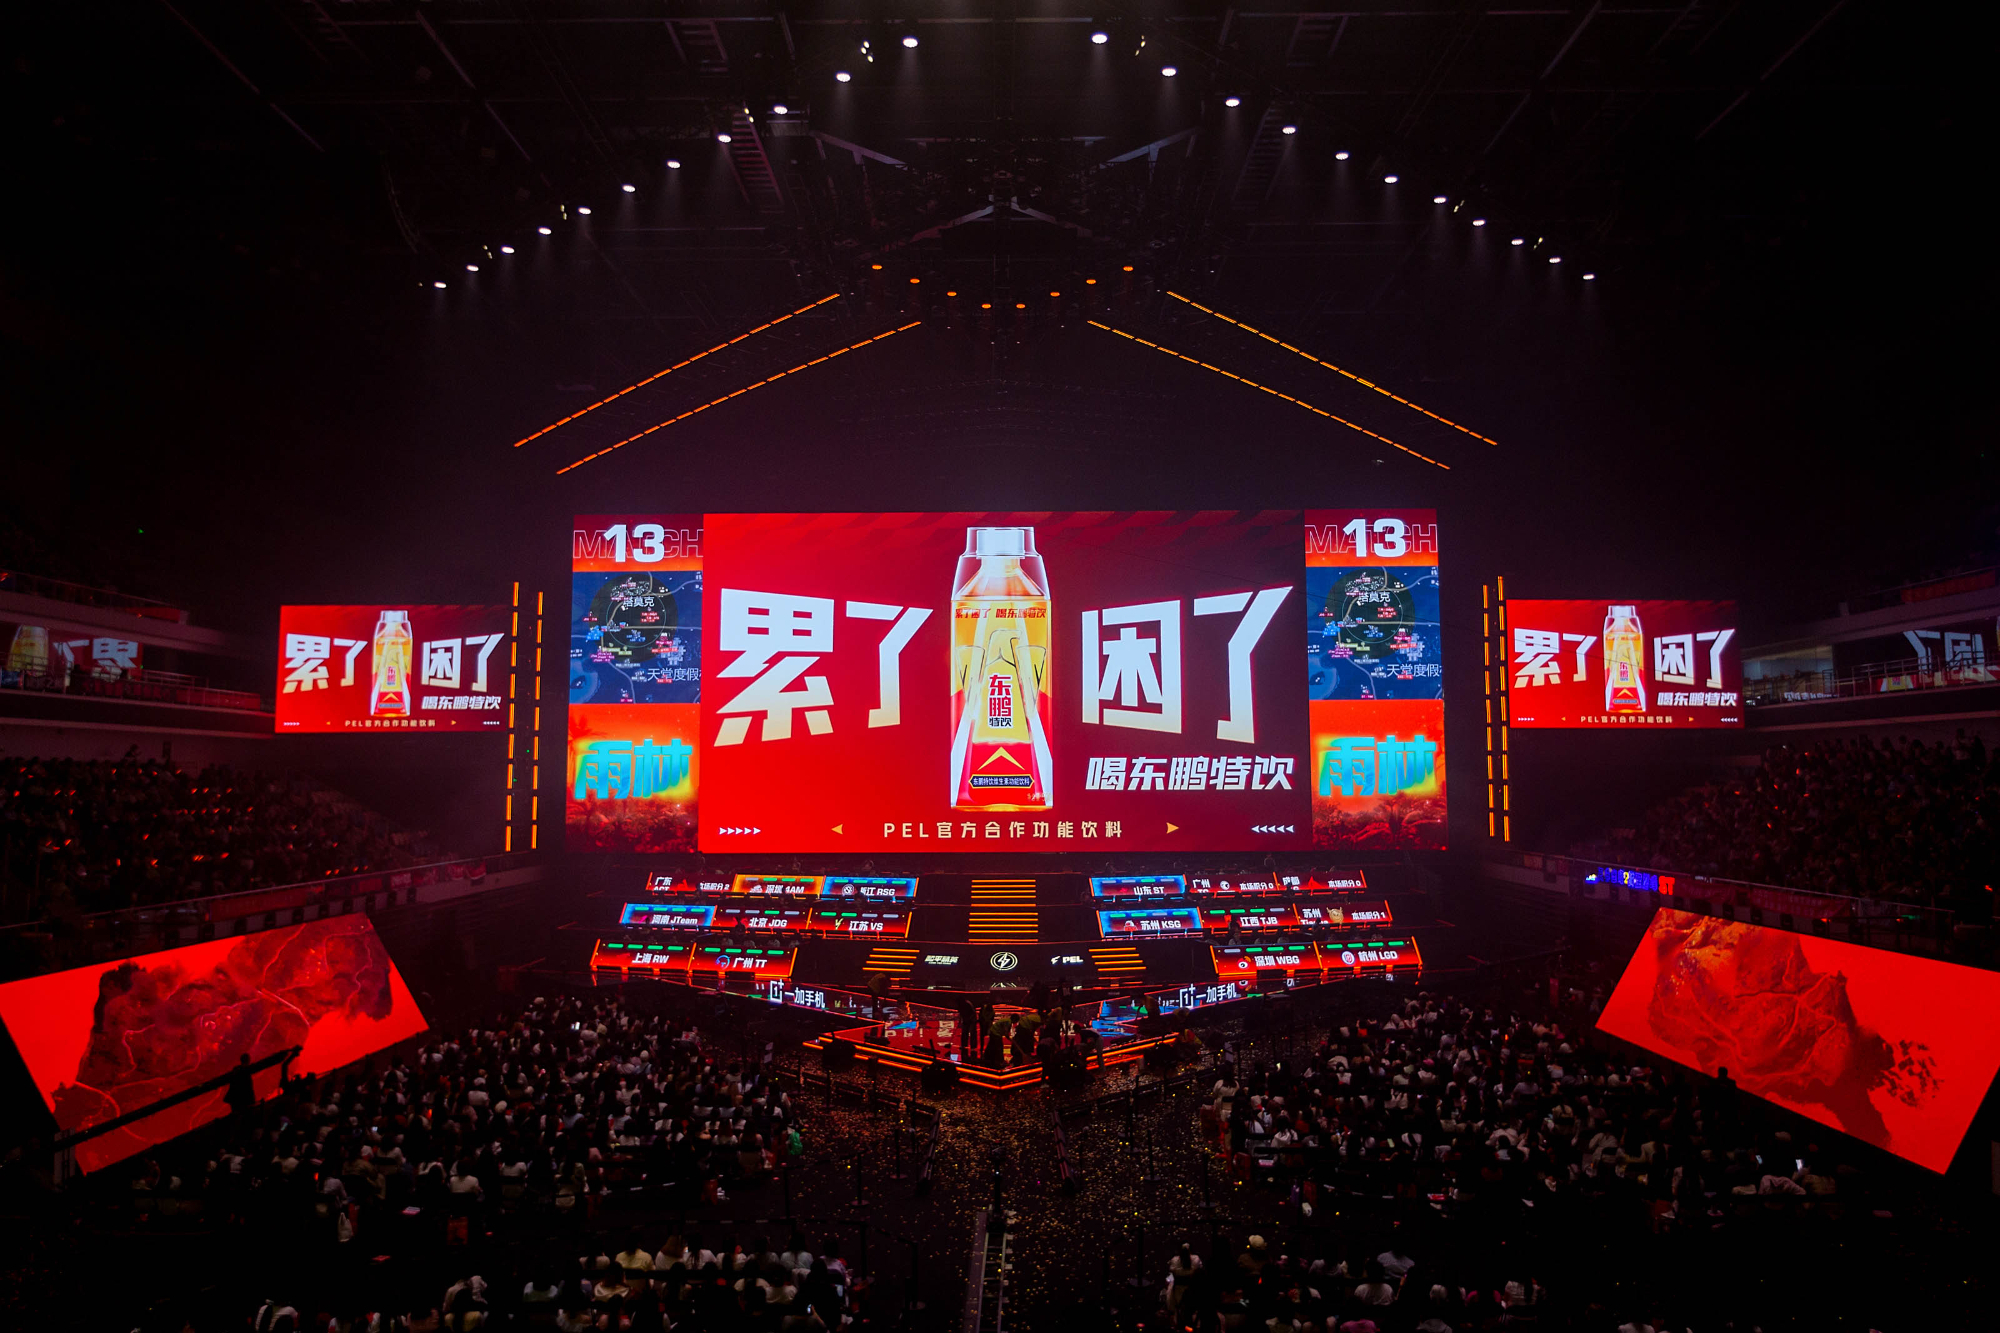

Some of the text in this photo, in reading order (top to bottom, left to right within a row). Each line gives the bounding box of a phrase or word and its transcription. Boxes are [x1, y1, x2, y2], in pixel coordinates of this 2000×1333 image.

[604, 523, 665, 562] 13
[1343, 519, 1405, 557] 13
[282, 633, 504, 694] 累了 困了
[1514, 628, 1735, 689] 累了 困了
[714, 586, 1293, 747] 累了 困了
[1387, 664, 1442, 677] 天堂度假
[647, 668, 702, 681] 天堂度假
[989, 675, 1011, 716] 东鹏
[1657, 692, 1737, 706] 喝东鹏特饮
[422, 696, 502, 710] 喝东鹏特饮
[989, 717, 1011, 727] 特饮
[575, 738, 693, 799] 雨林
[1319, 734, 1436, 796] 雨林
[1085, 756, 1294, 791] 喝东鹏特饮
[884, 820, 1123, 839] PEL官方合作功能饮料
[655, 876, 672, 886] 广东
[1192, 878, 1211, 889] 广州
[785, 886, 805, 894] 4AM
[876, 888, 896, 897] RSG
[1134, 886, 1165, 895] 山东 ST
[1302, 908, 1321, 918] 苏州
[670, 916, 698, 925] JTeam
[749, 917, 788, 928] 北京 JDG
[848, 920, 884, 931] 江苏 VS
[1140, 920, 1181, 931] 苏州 KSG
[1240, 916, 1278, 926] 江西 TJB
[632, 952, 669, 964] 上海 RW
[1254, 955, 1300, 967] 深圳 WBG
[1358, 951, 1398, 962] 杭州 LGD
[732, 957, 767, 969] 广州 TT
[784, 987, 826, 1008] 一加手机
[1196, 982, 1237, 1003] 一加手机
